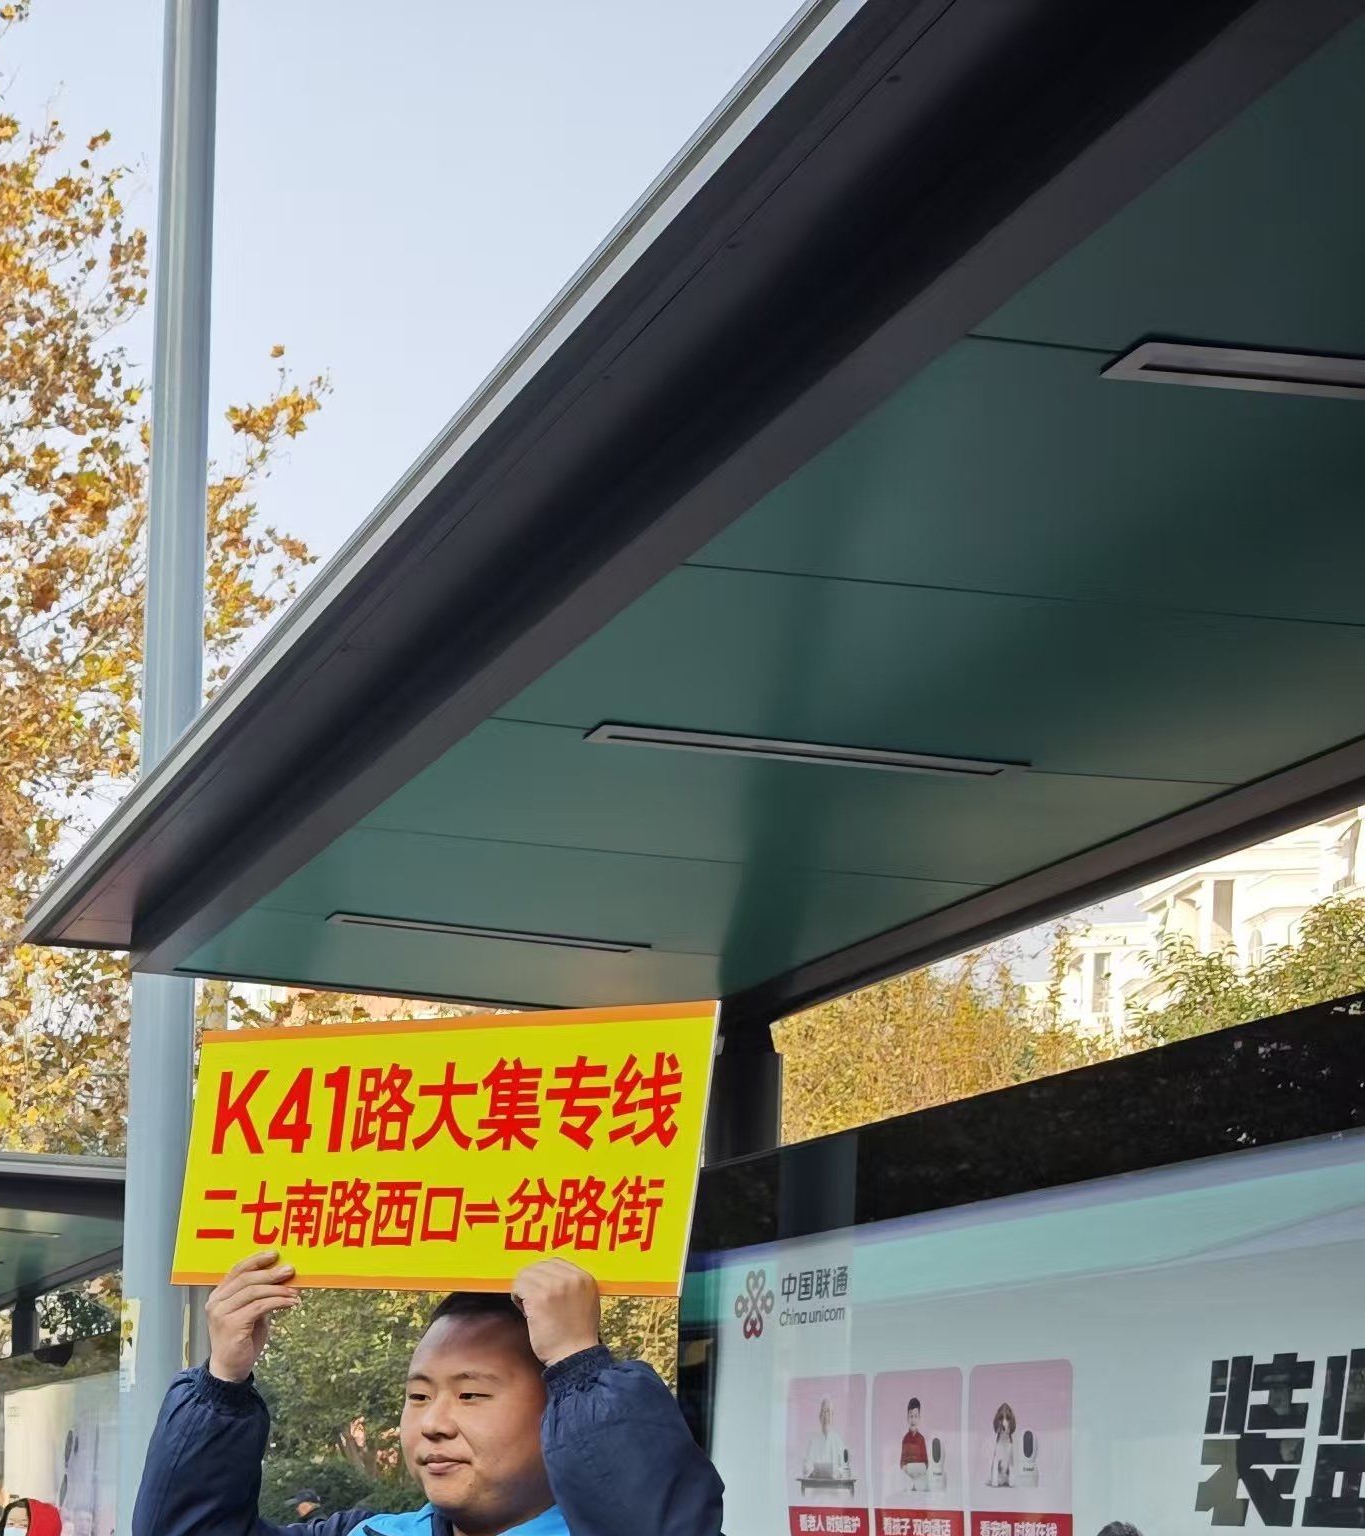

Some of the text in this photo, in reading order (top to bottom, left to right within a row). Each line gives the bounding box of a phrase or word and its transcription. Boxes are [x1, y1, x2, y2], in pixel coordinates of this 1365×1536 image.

[210, 1052, 683, 1155] K41路大集专线
[196, 1175, 665, 1252] 二七南路西口 岔路街
[781, 1265, 849, 1303] 中国联通
